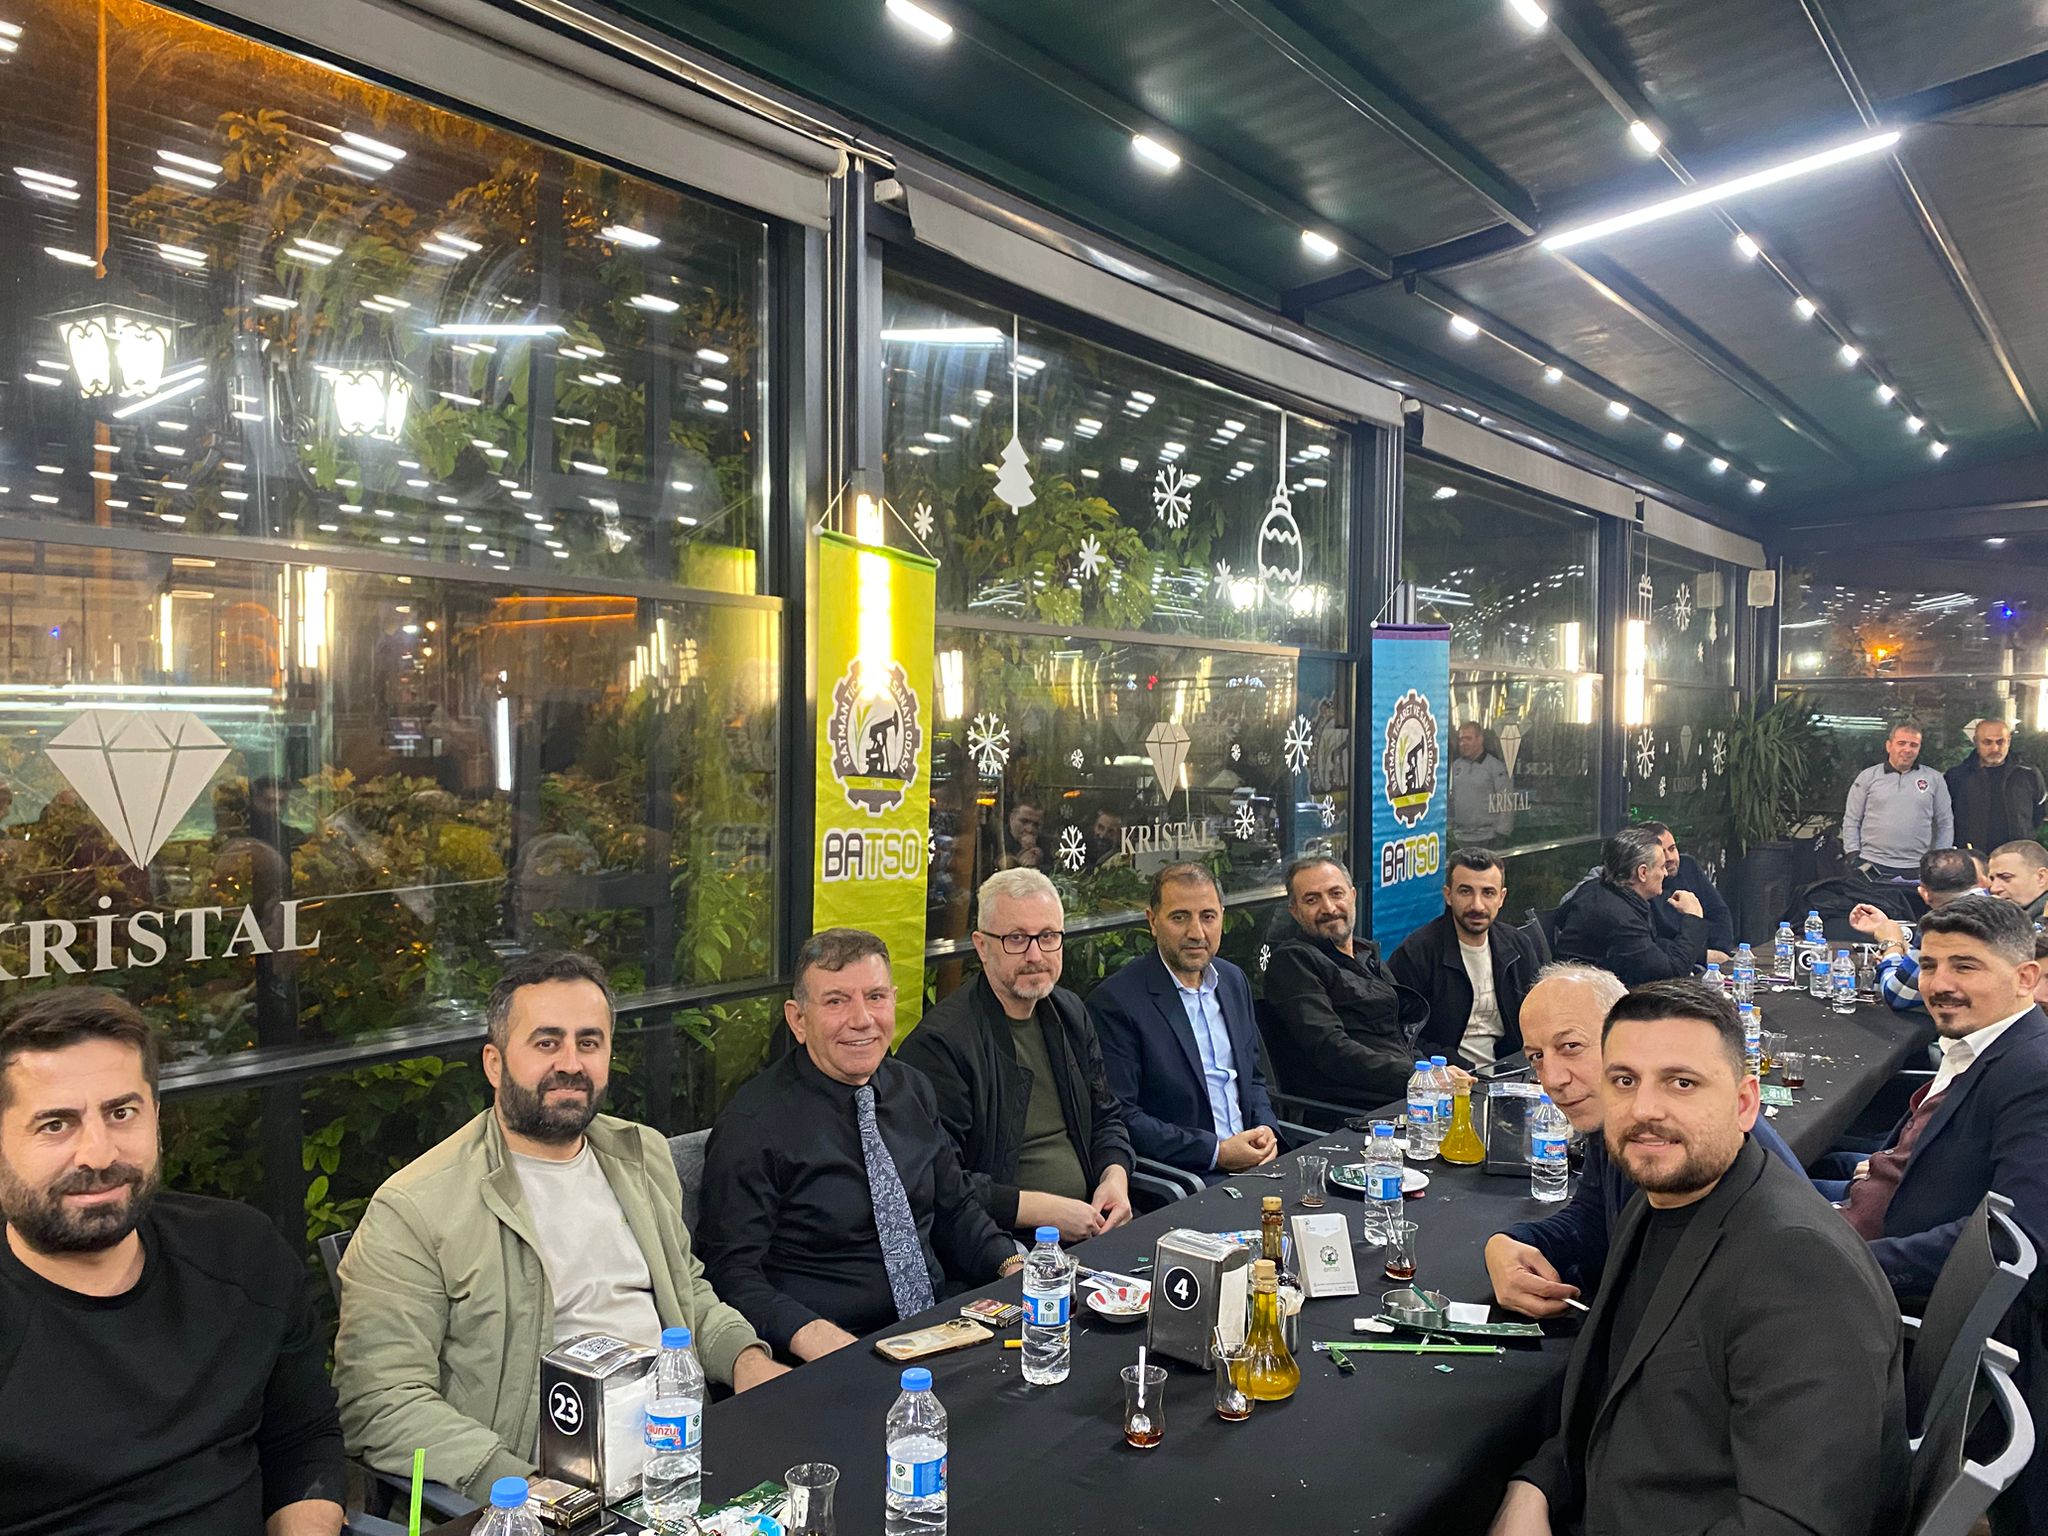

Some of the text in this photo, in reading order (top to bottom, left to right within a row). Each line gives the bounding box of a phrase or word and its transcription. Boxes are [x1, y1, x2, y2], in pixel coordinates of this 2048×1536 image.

[838, 702, 851, 768] BATMAN
[900, 730, 913, 774] ODASI
[1488, 788, 1532, 813] KRİSTAL
[823, 830, 922, 880] BATSO
[1120, 817, 1213, 855] KRİSTAL
[1382, 834, 1439, 885] BATSO
[1173, 1278, 1191, 1301] 4
[553, 1393, 579, 1425] 23
